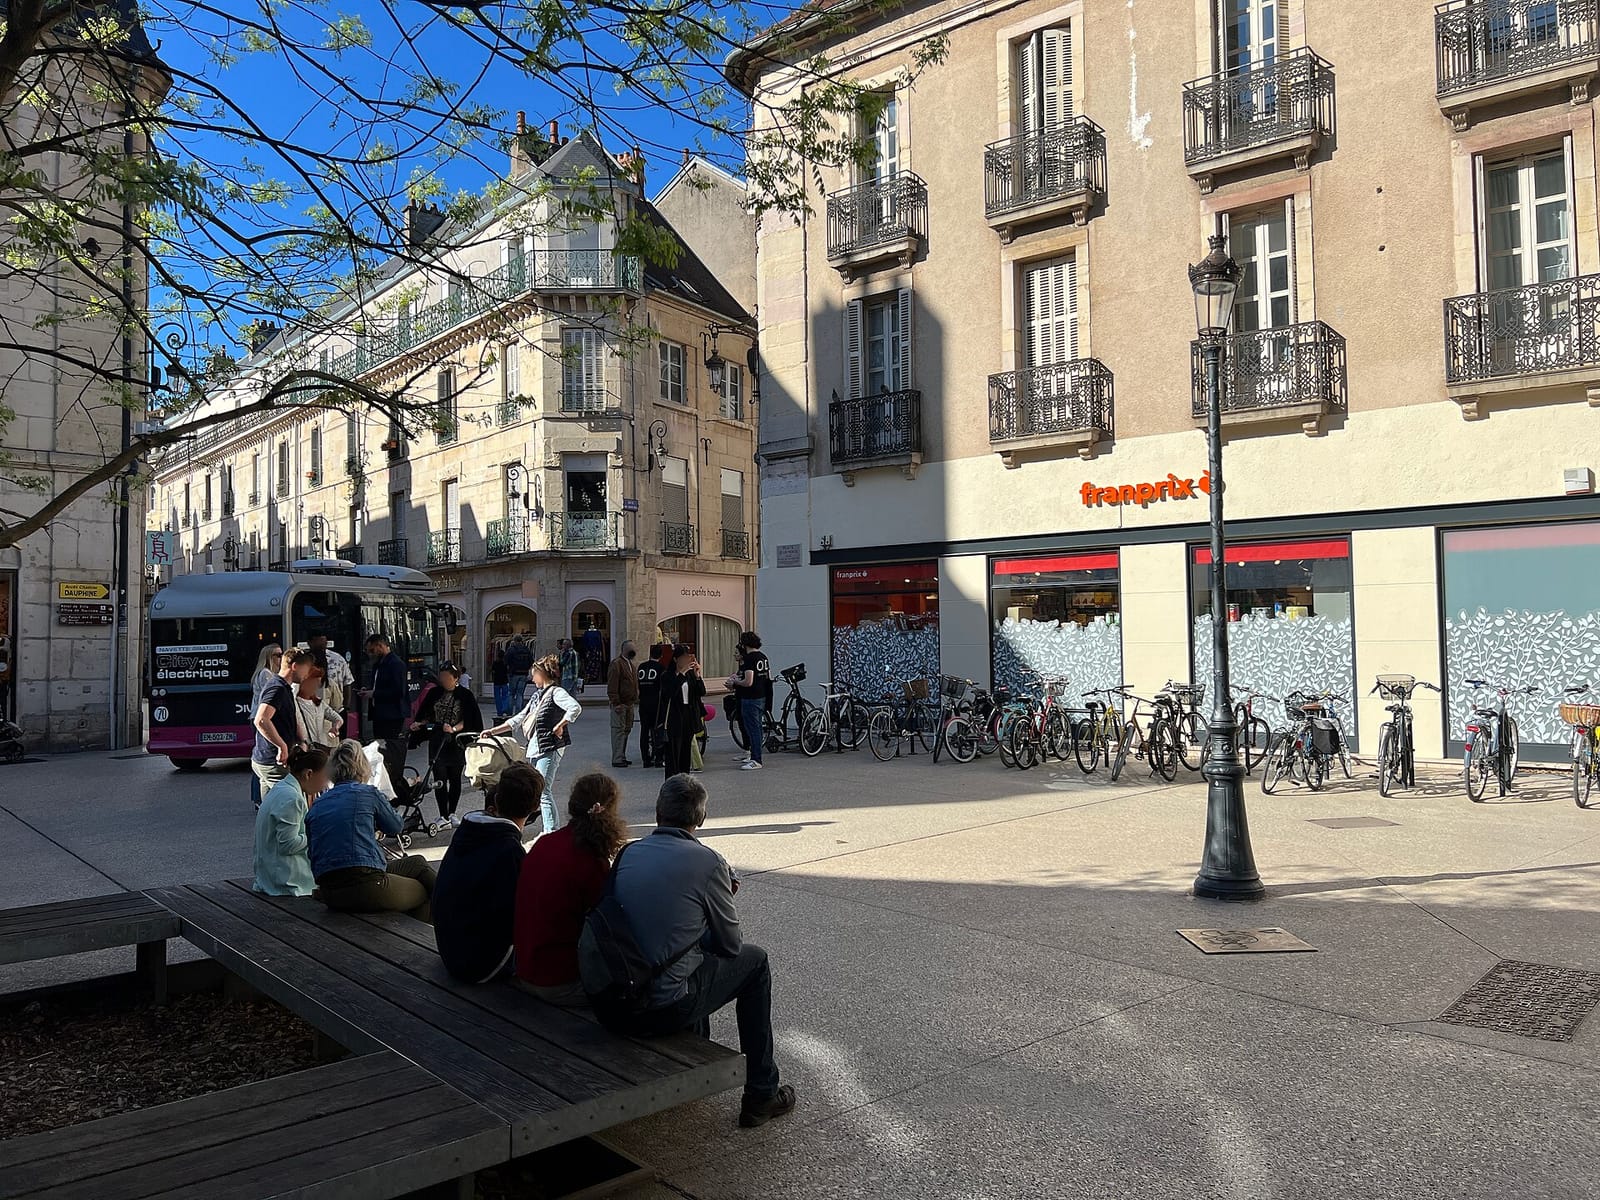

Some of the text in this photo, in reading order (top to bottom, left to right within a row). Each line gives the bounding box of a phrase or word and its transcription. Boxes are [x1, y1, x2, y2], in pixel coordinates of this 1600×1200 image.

[1079, 473, 1194, 504] franprix
[836, 571, 862, 579] franprix
[680, 586, 721, 597] des petits hauts
[156, 654, 229, 670] City 100%
[157, 668, 229, 679] électrique
